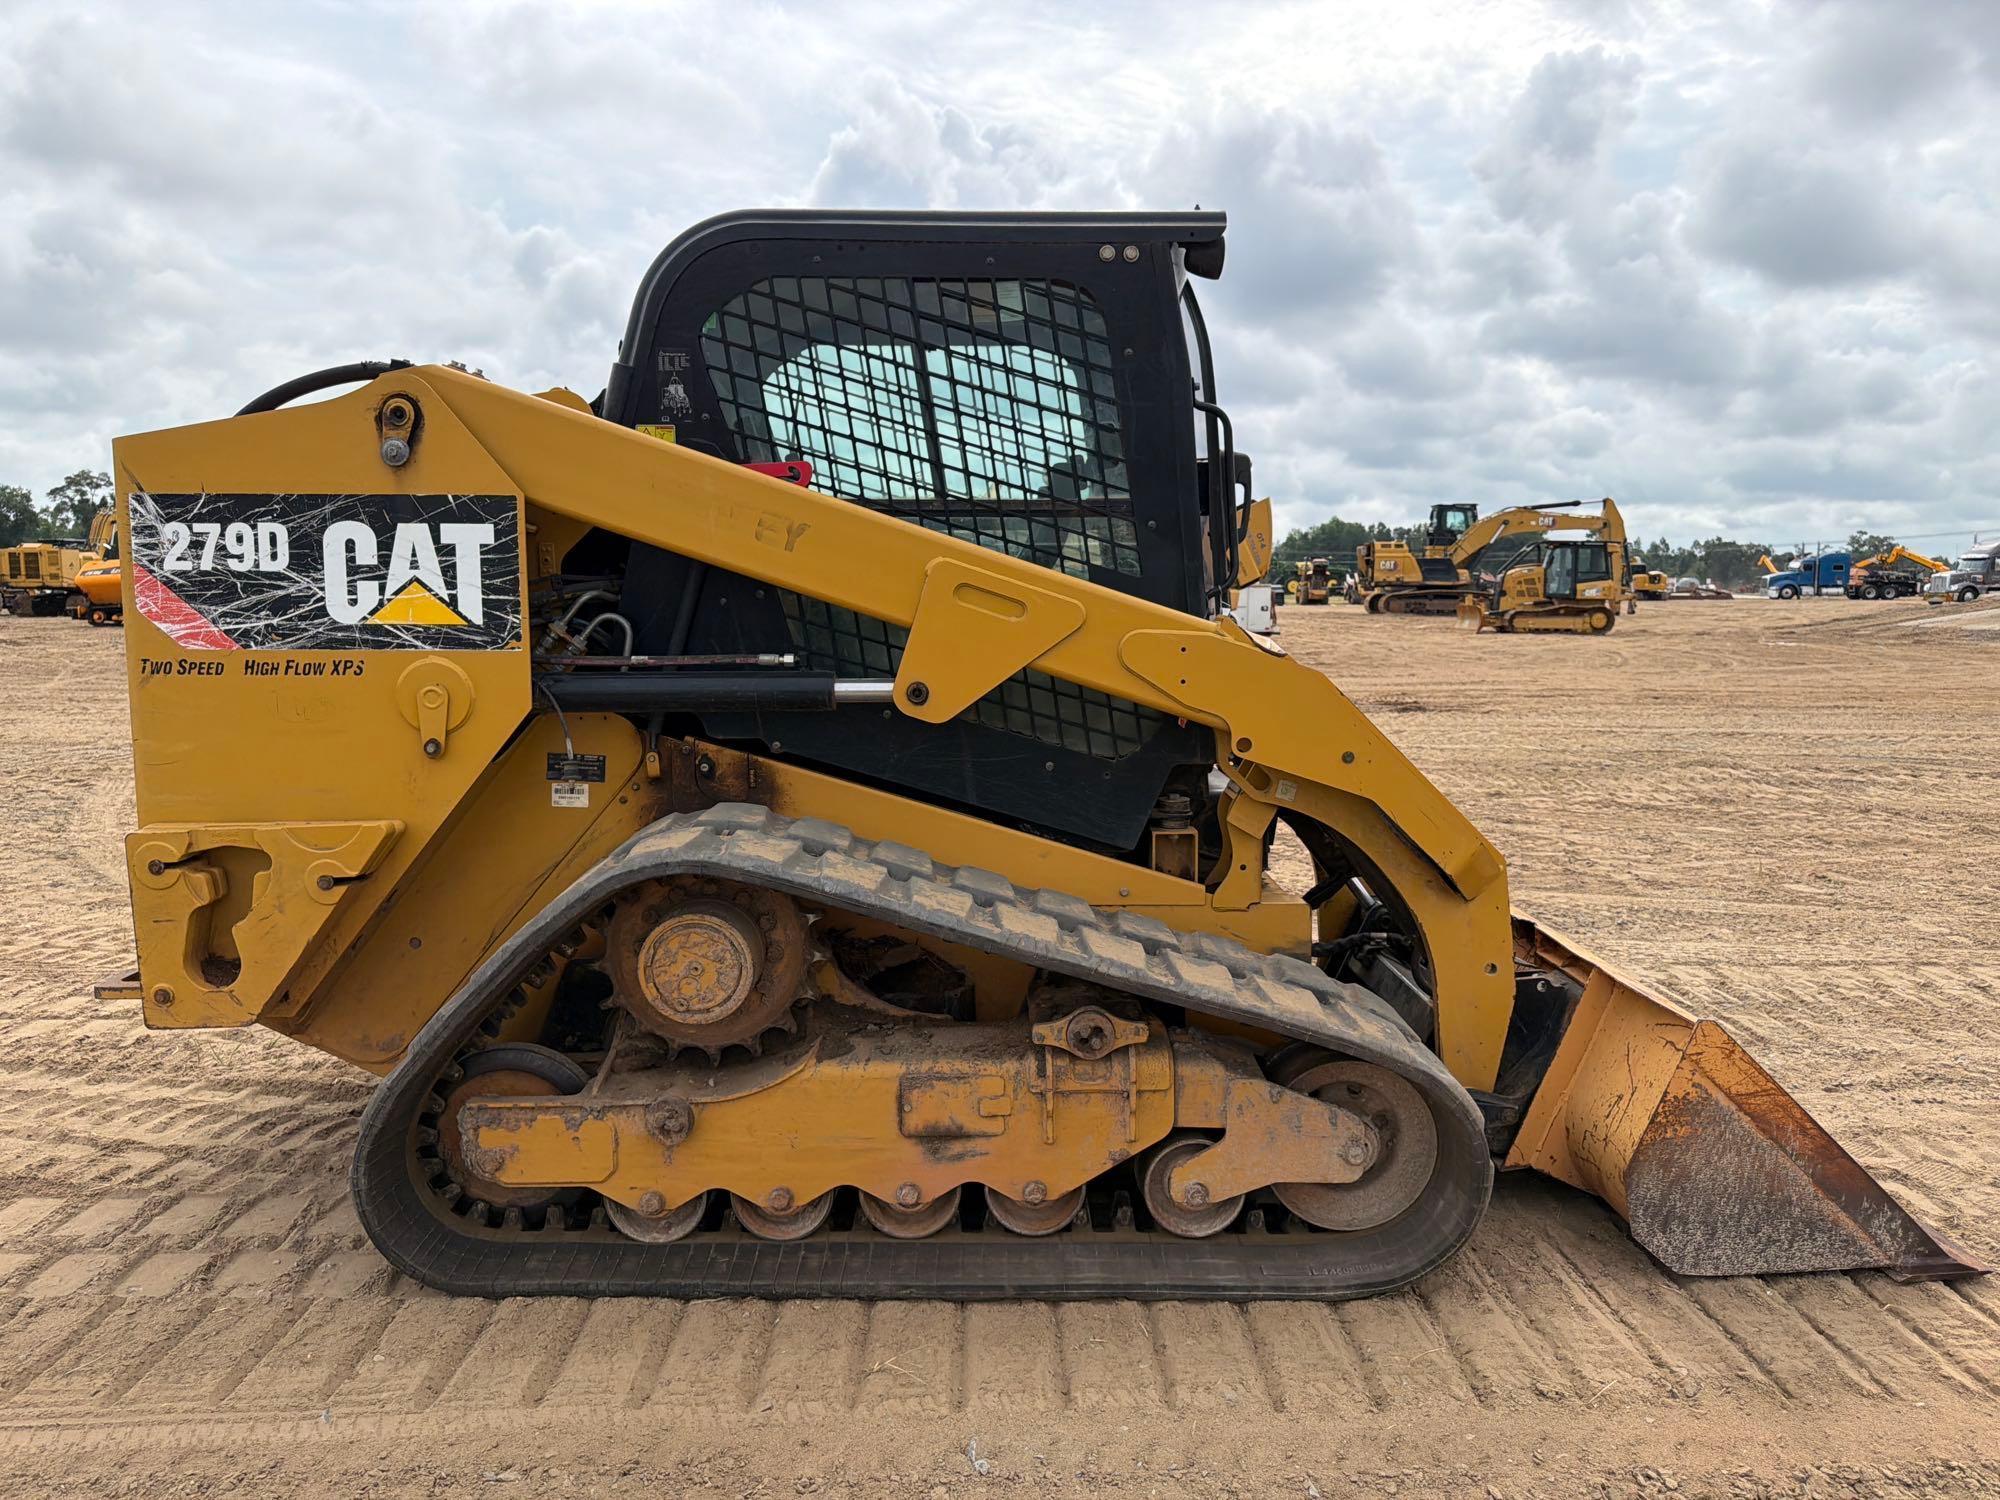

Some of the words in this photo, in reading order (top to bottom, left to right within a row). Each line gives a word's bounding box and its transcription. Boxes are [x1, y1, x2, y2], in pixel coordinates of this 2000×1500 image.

[1538, 516, 1554, 526] CAT
[1380, 560, 1396, 570] CAT
[163, 521, 290, 573] 279D
[322, 520, 495, 626] CAT
[140, 658, 173, 676] TWO
[176, 658, 225, 676] SPEED
[243, 659, 279, 676] HIGH
[284, 659, 327, 676] FLOW
[330, 659, 365, 676] XPS
